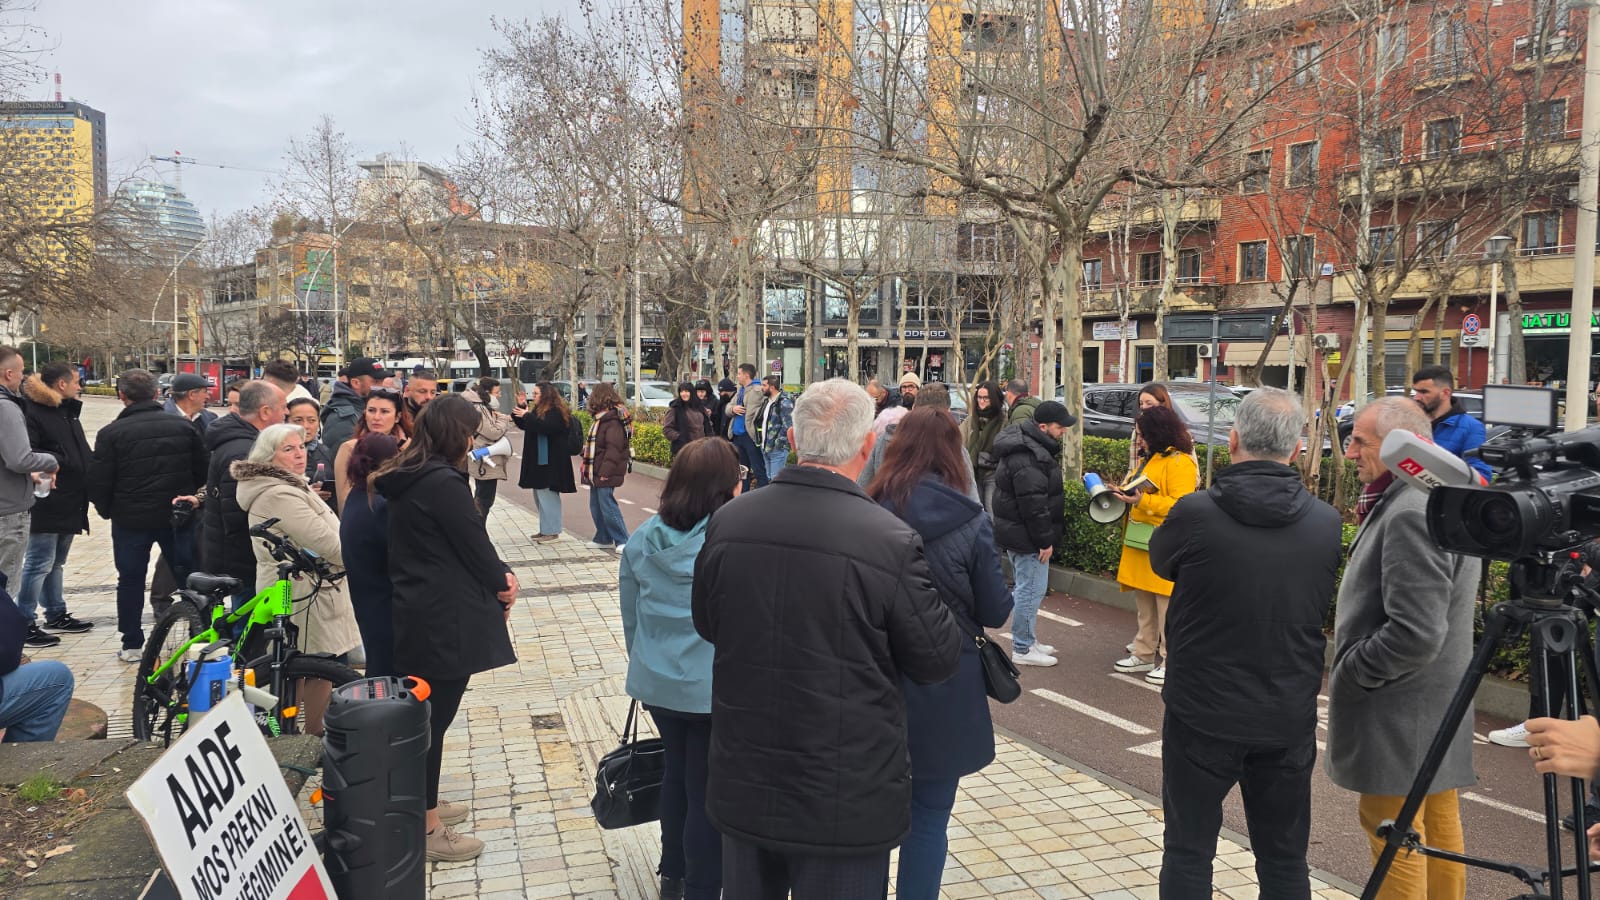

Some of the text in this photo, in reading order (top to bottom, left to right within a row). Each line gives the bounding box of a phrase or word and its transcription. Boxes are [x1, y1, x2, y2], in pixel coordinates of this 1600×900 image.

[1401, 462, 1417, 474] TV
[166, 720, 246, 850] AADF
[191, 783, 278, 900] MOS PREKNI
